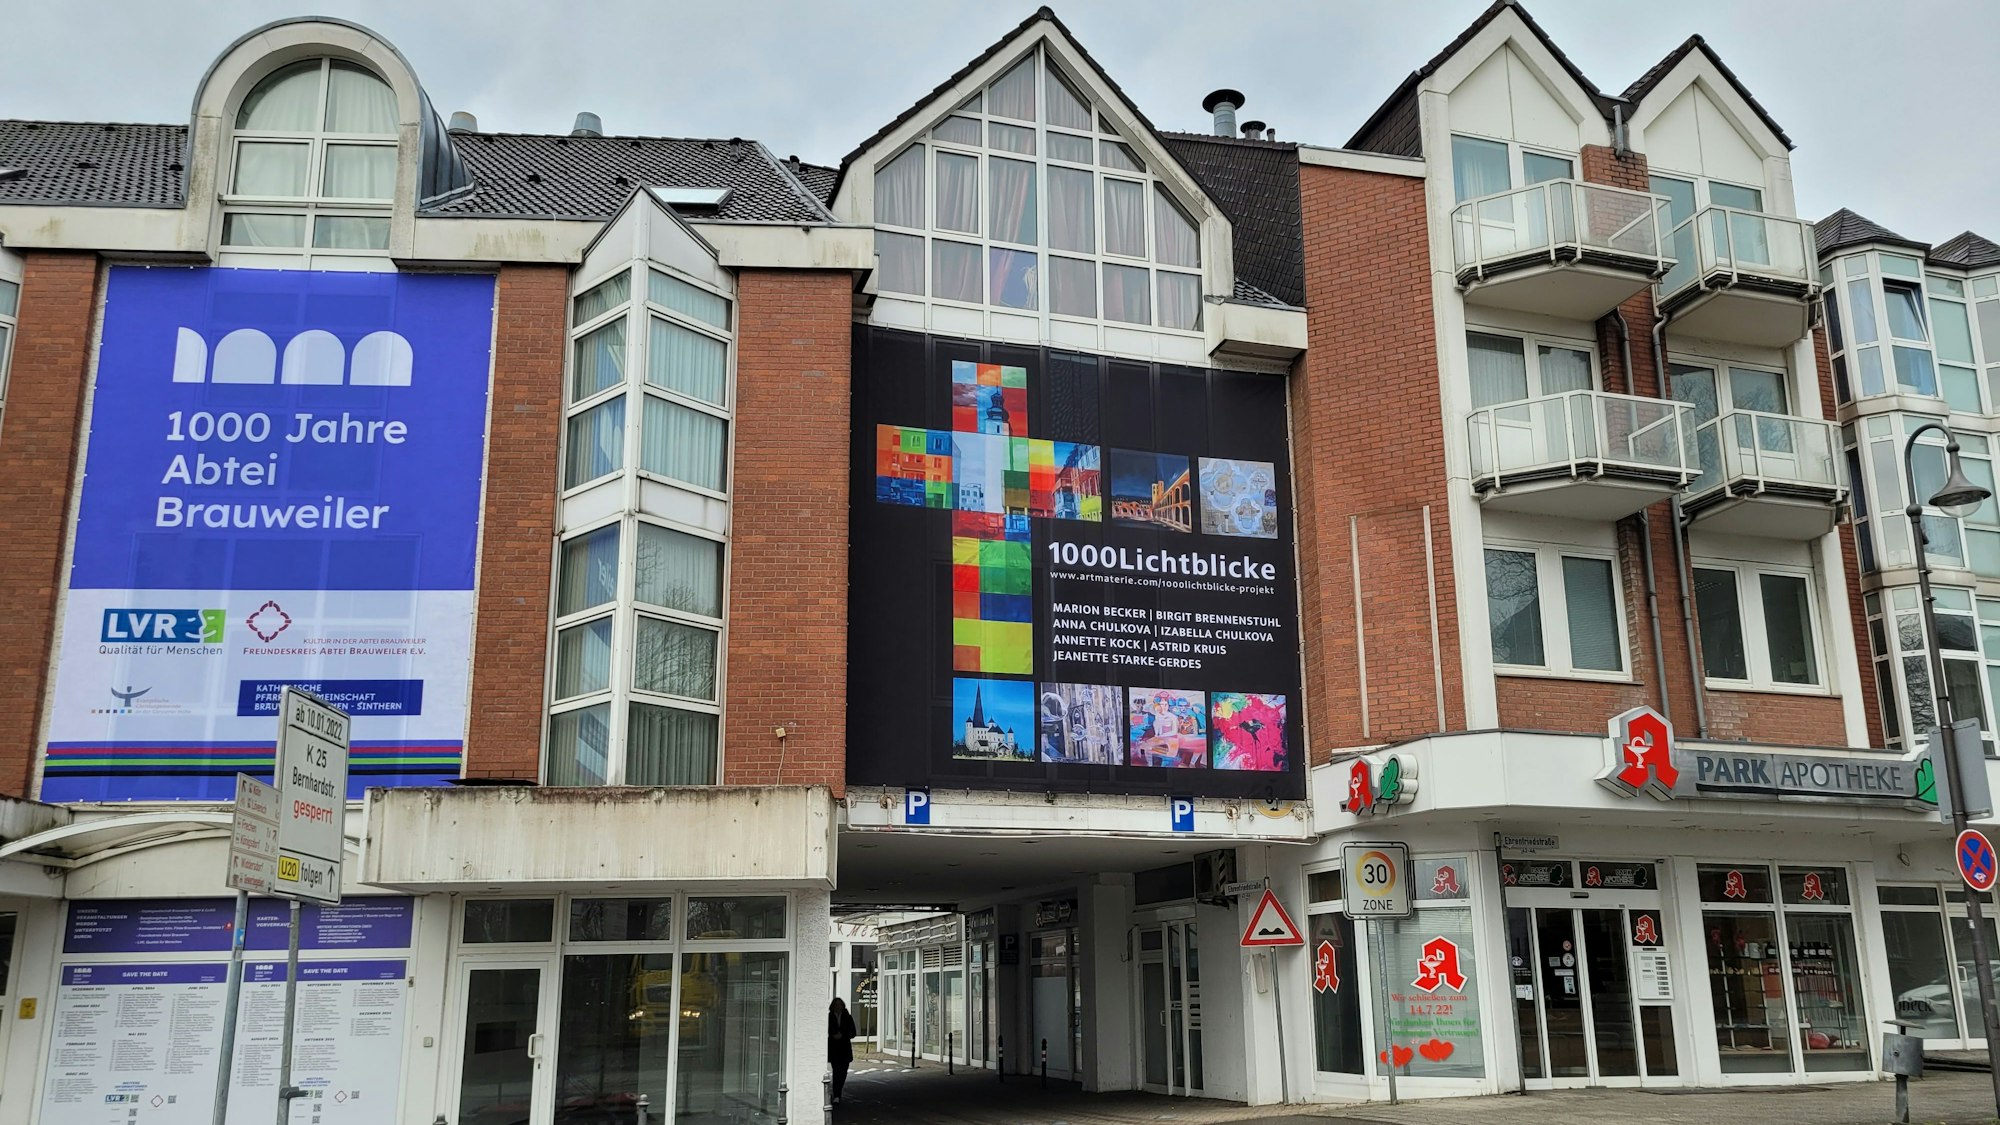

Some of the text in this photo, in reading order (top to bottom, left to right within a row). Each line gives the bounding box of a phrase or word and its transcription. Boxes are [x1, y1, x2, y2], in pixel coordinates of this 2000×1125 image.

[166, 411, 407, 444] 1000 Jahre
[161, 453, 278, 485] Abtei
[156, 495, 389, 529] Brauweiler
[1049, 541, 1276, 580] 1000Lichtblicke
[1050, 571, 1274, 595] www.artmaterie.com/1000lichtblicke-projekt
[108, 613, 177, 638] LVR
[1053, 603, 1100, 615] MARION
[1103, 607, 1146, 618] BECKER
[1156, 611, 1192, 622] BIRGIT
[1195, 614, 1281, 627] BRENNENSTUHL
[1053, 619, 1086, 630] ANNA
[1090, 621, 1151, 634] CHULKOVA
[1161, 627, 1212, 639] IZABELLA
[1216, 630, 1274, 642] CHULKOVA
[99, 645, 223, 655] Qualität für Menschen
[1053, 635, 1106, 647] ANNETTE
[1110, 639, 1140, 650] KOCK
[1151, 641, 1190, 653] ASTRID
[1194, 644, 1226, 655] KRUIS
[1053, 651, 1201, 669] JEANETTE STARKE-GERDES
[296, 705, 342, 741] ab 10.01.2022
[306, 744, 327, 768] K 25
[292, 767, 336, 799] Bernhardstr.
[1696, 756, 1904, 791] PARK APOTHEKE
[294, 800, 332, 824] gesperrt
[1504, 837, 1555, 846] Ehrenfriedstraße
[281, 860, 297, 877] U20
[301, 863, 322, 888] folgen
[1364, 864, 1387, 884] 30
[1363, 900, 1393, 910] ZONE
[1410, 1005, 1453, 1015] 14.7.22!
[1433, 1028, 1478, 1037] Vertrauen!
